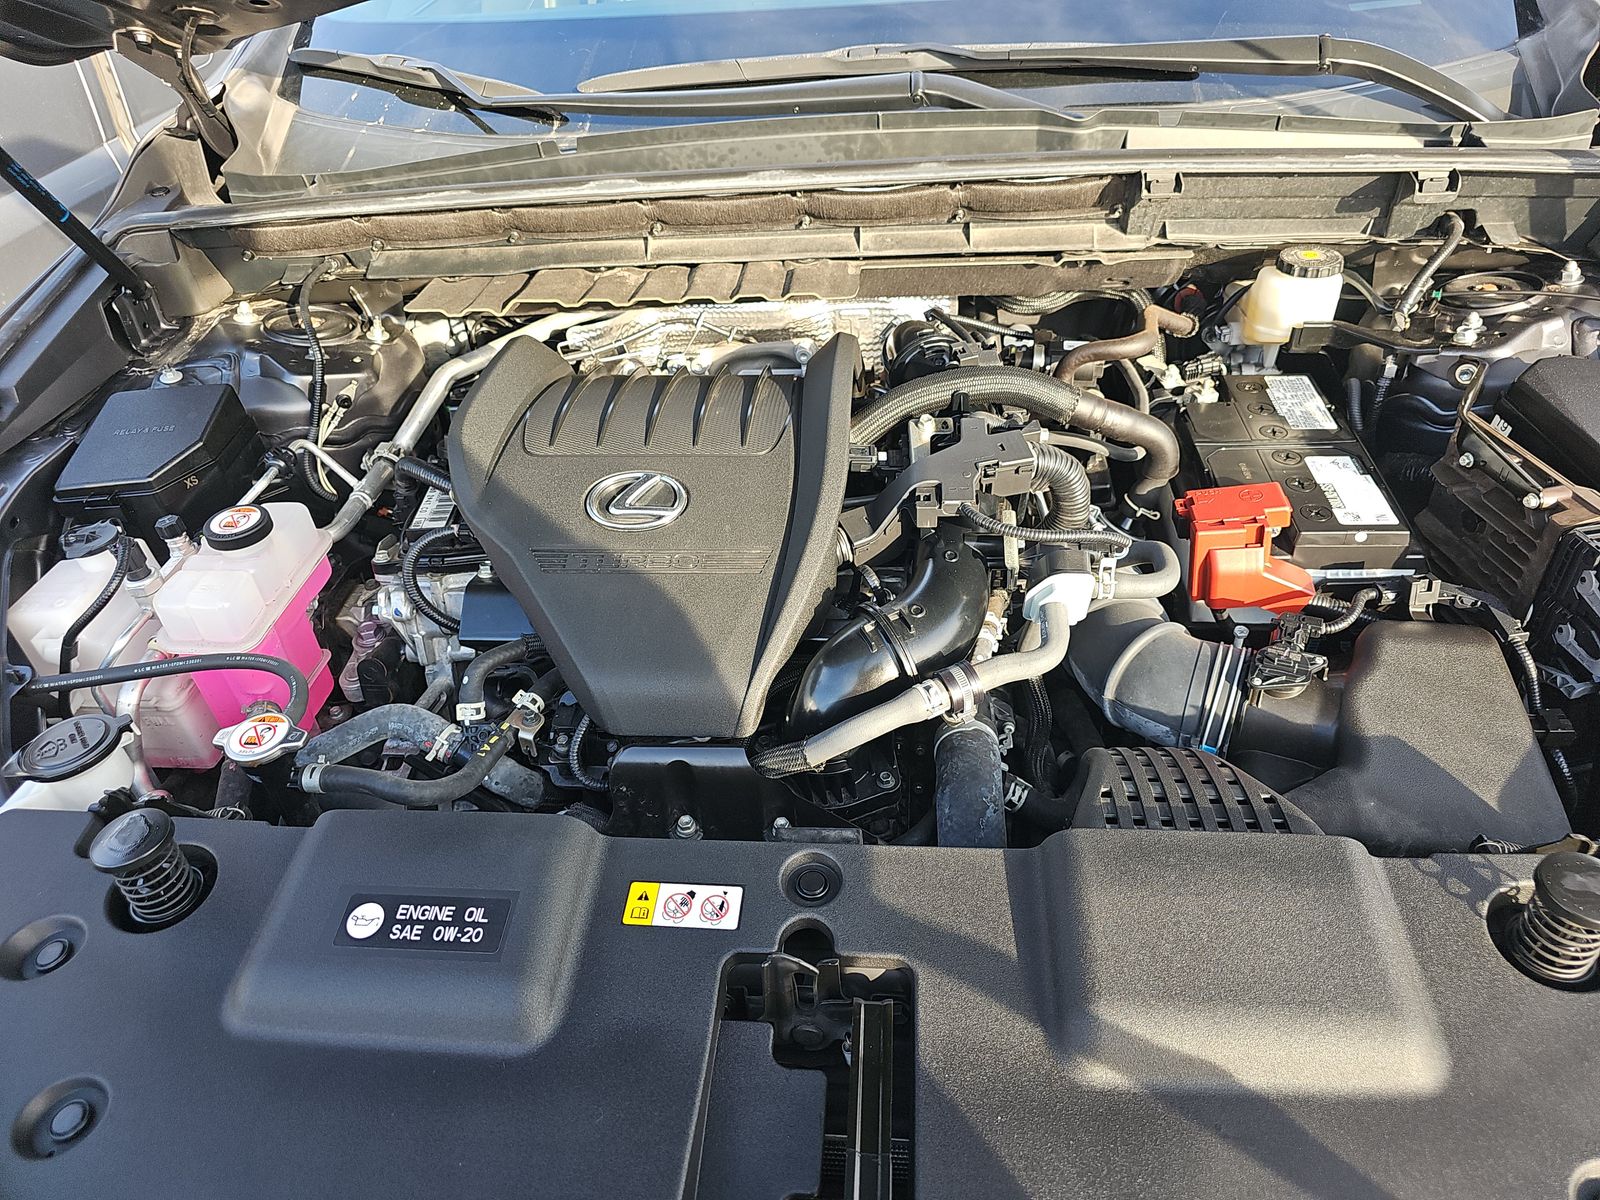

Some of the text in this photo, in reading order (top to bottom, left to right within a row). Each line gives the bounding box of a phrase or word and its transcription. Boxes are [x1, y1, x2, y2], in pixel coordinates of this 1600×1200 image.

[151, 425, 176, 434] FUSE
[183, 475, 199, 489] XS
[570, 552, 701, 571] TURBO
[396, 904, 489, 923] ENGINE OIL
[389, 924, 484, 943] SAE 0W-20
